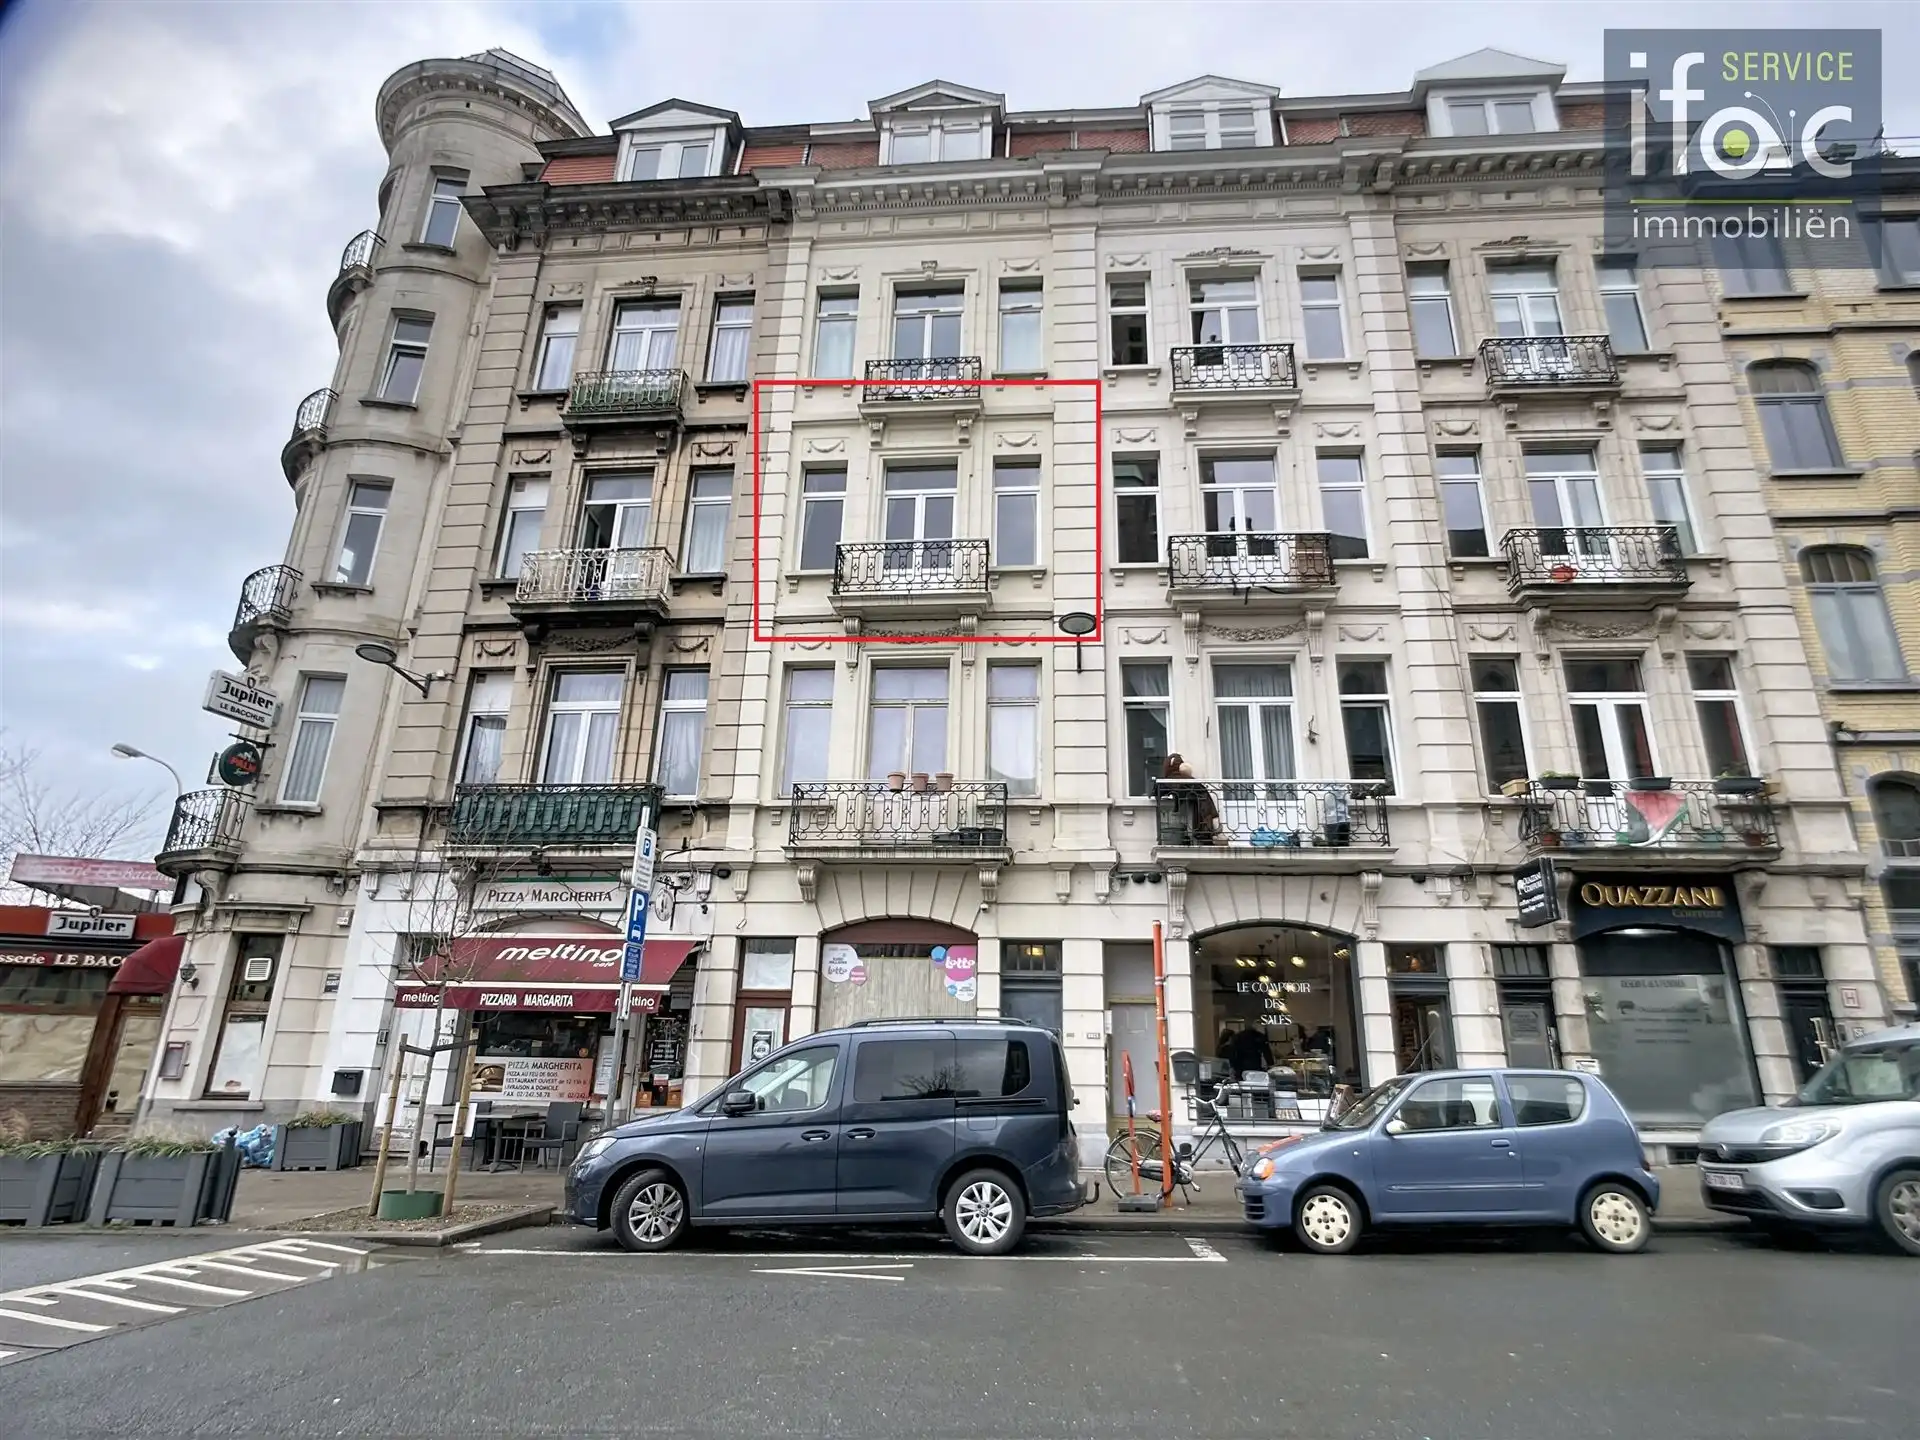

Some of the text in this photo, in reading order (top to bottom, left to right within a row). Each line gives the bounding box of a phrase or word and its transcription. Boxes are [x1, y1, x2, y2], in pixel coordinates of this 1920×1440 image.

[220, 680, 274, 709] Jupiler
[220, 702, 266, 723] LE BACCHUS
[488, 889, 612, 902] PIZZA MARGHERITA
[634, 893, 645, 922] P
[56, 917, 126, 932] Jupiler
[496, 943, 623, 962] meltino
[53, 954, 78, 965] LE
[1236, 981, 1311, 993] LE COMPTOIR
[480, 993, 574, 1007] PIZZARIA MARGARITA
[615, 996, 655, 1007] mltino
[1264, 998, 1286, 1009] DES
[508, 1061, 582, 1070] PIZZA MARGHERITA
